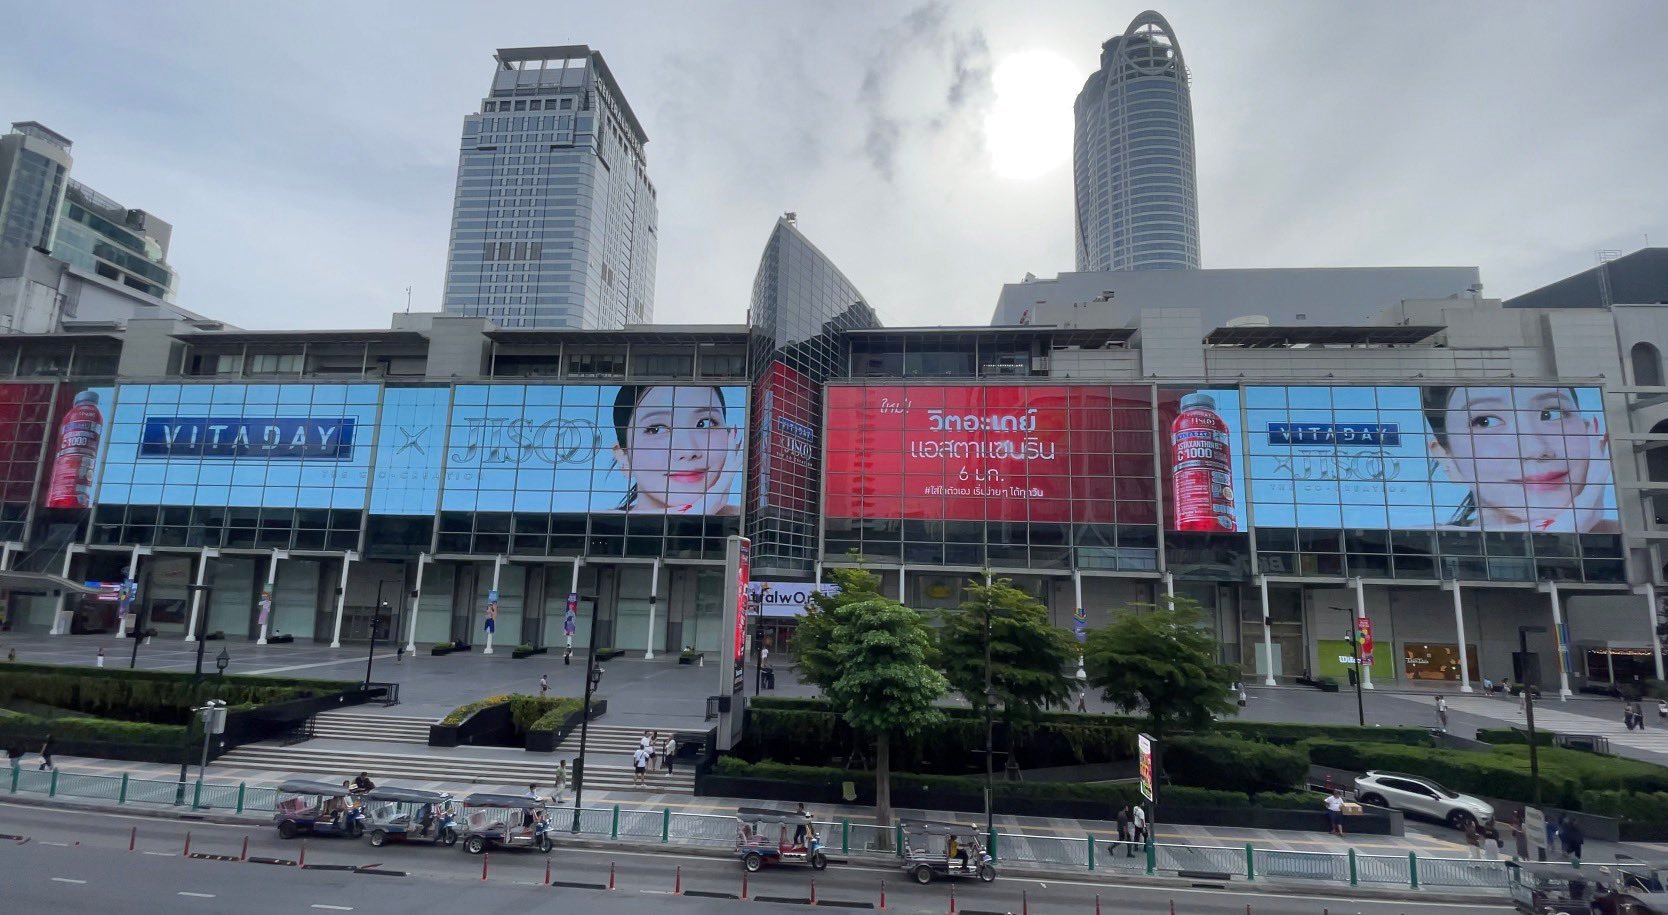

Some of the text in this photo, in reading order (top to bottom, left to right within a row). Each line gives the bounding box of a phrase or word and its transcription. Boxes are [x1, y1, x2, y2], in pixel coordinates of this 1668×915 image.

[927, 408, 1038, 433] วิตอะเดย์
[163, 425, 336, 450] VITADAY
[451, 417, 602, 465] JISOO
[1280, 427, 1387, 440] VITADAY
[959, 466, 969, 481] 6
